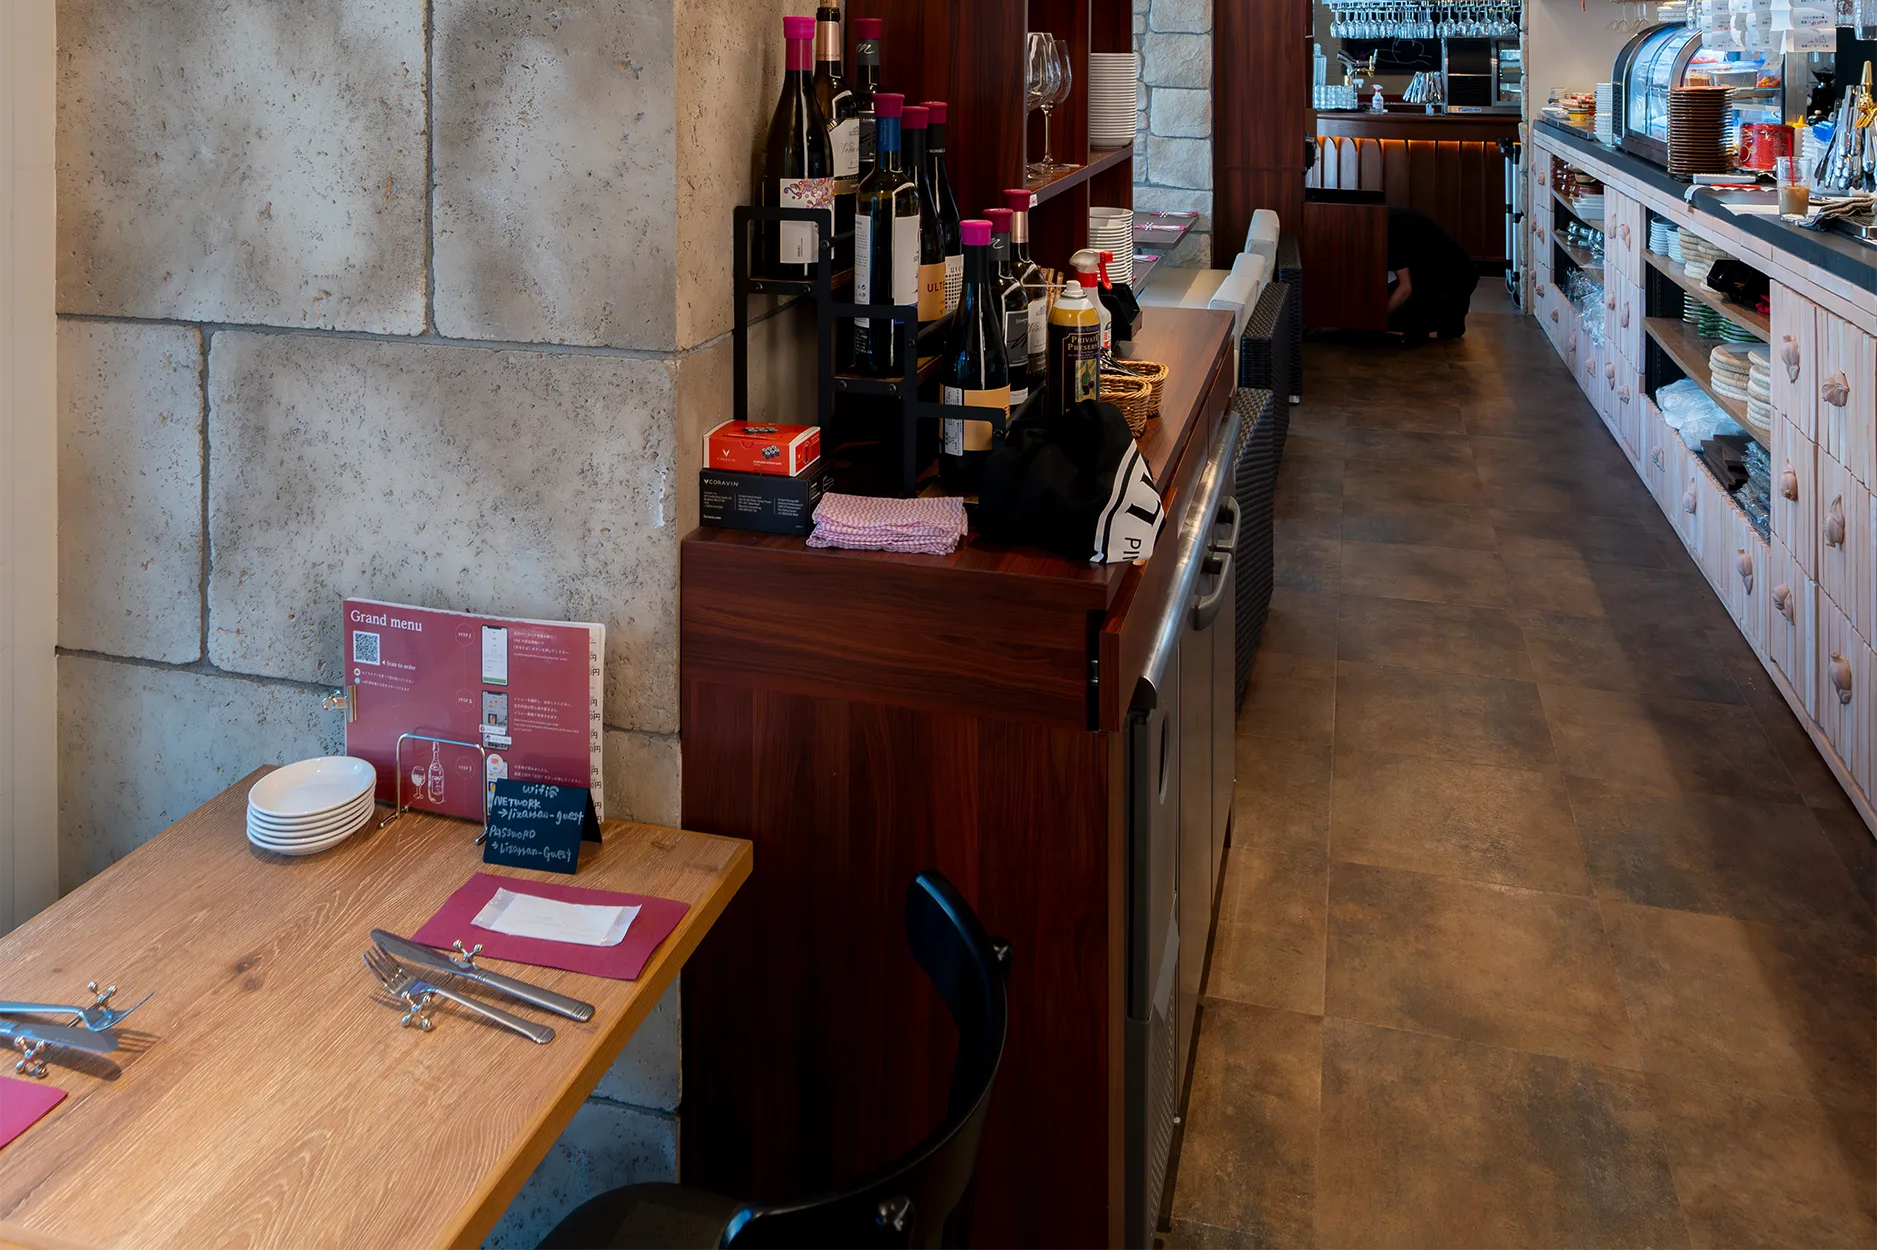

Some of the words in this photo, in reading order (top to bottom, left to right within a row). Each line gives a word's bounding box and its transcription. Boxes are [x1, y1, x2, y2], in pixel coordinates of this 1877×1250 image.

[350, 609, 387, 626] Grand
[390, 617, 422, 632] menu
[522, 784, 549, 798] wifi
[494, 795, 541, 809] NETWORK
[488, 824, 536, 841] PASSWORD
